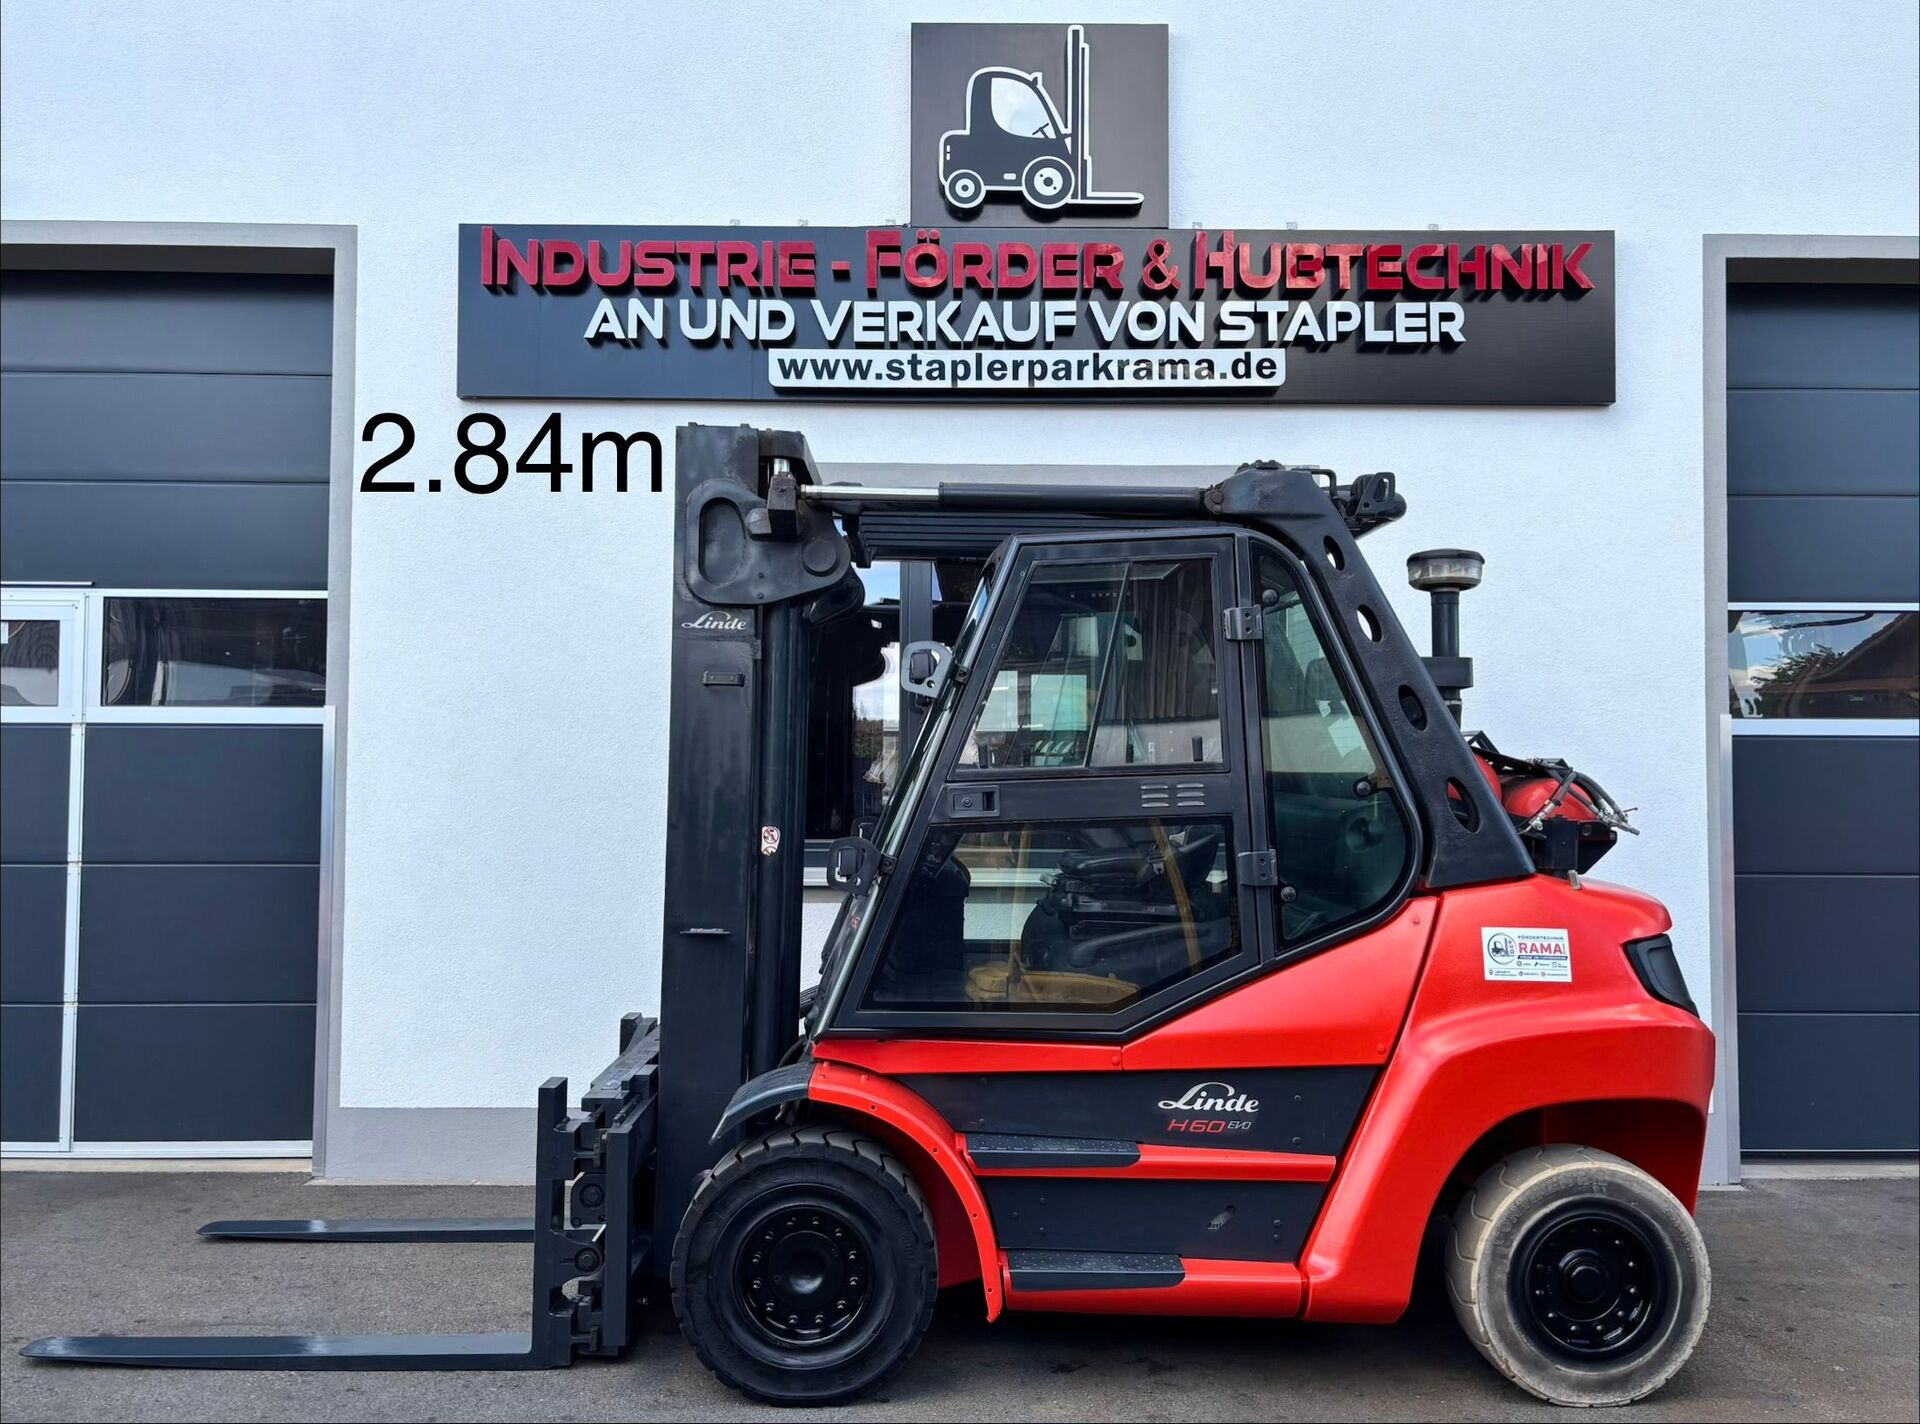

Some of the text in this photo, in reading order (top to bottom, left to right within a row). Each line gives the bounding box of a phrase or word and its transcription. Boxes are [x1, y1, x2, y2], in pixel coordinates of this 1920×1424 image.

[481, 226, 816, 288] INDUSTRIE
[866, 229, 1124, 291] FÖRDER
[1142, 239, 1182, 291] &
[584, 298, 1467, 344] AN UND VERKAUF VON STAPLER
[777, 351, 1278, 388] www.staplerparkrama.de
[681, 610, 747, 630] Linde
[1518, 942, 1563, 955] RAMA
[1158, 1081, 1260, 1113] Linde
[1227, 1120, 1252, 1130] EVO
